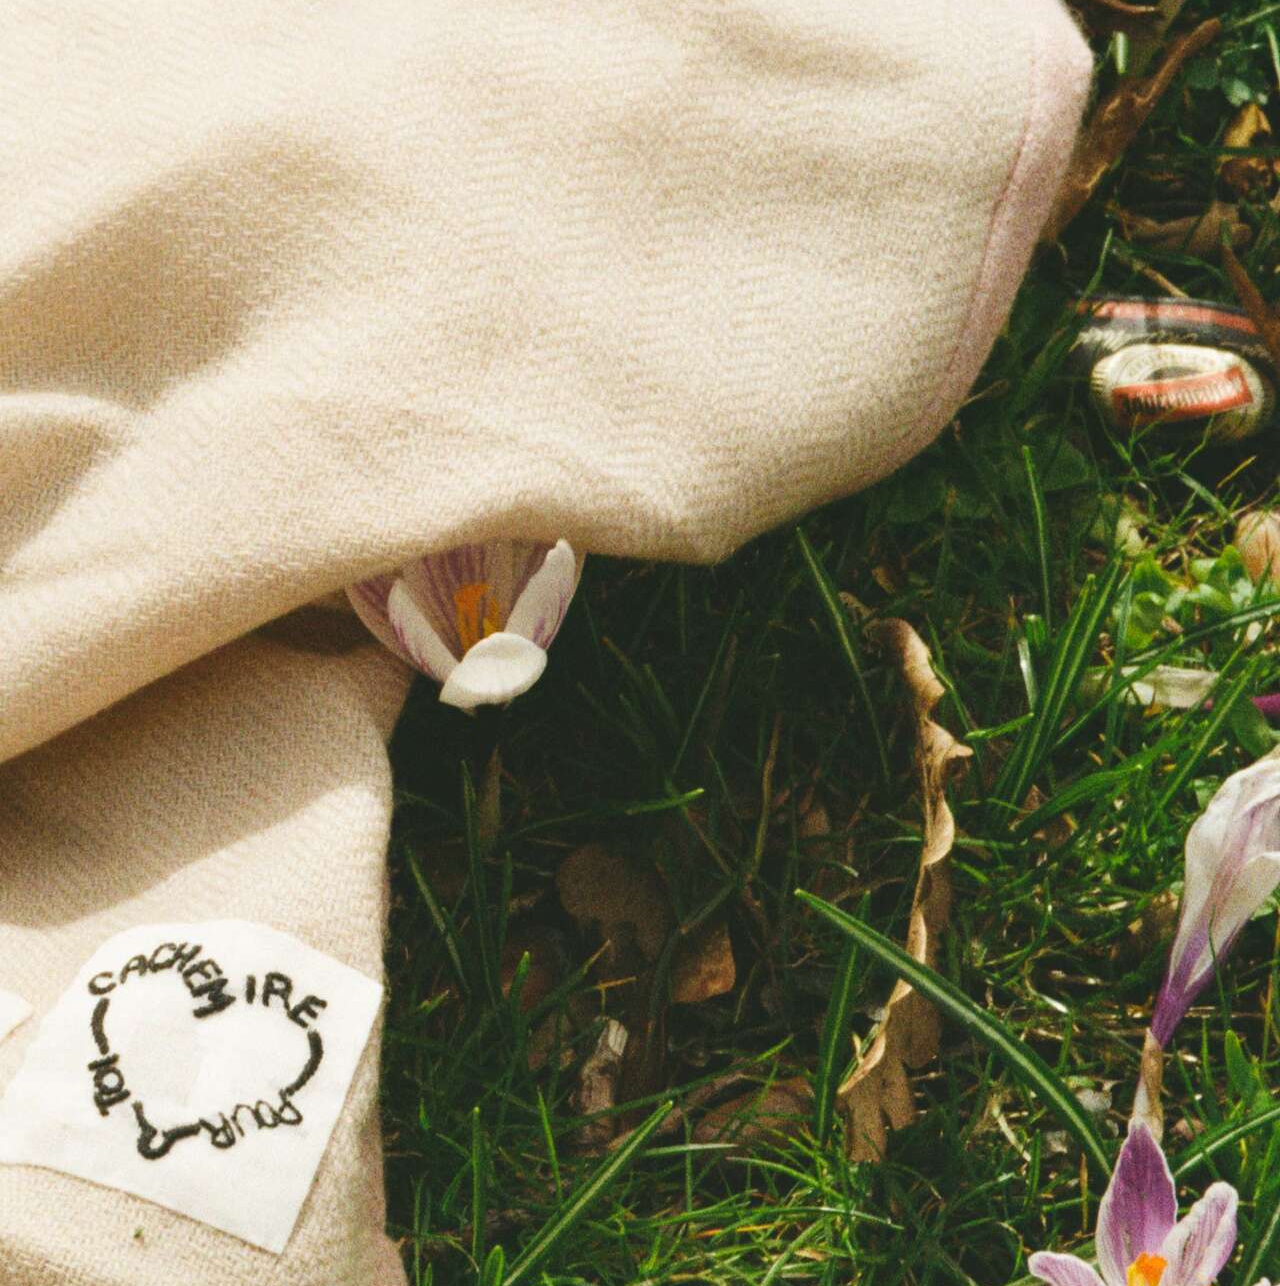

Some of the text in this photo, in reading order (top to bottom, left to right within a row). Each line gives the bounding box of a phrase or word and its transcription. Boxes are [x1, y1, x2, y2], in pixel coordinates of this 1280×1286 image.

[87, 942, 328, 1150] CACHEMIRE POUR TOI
